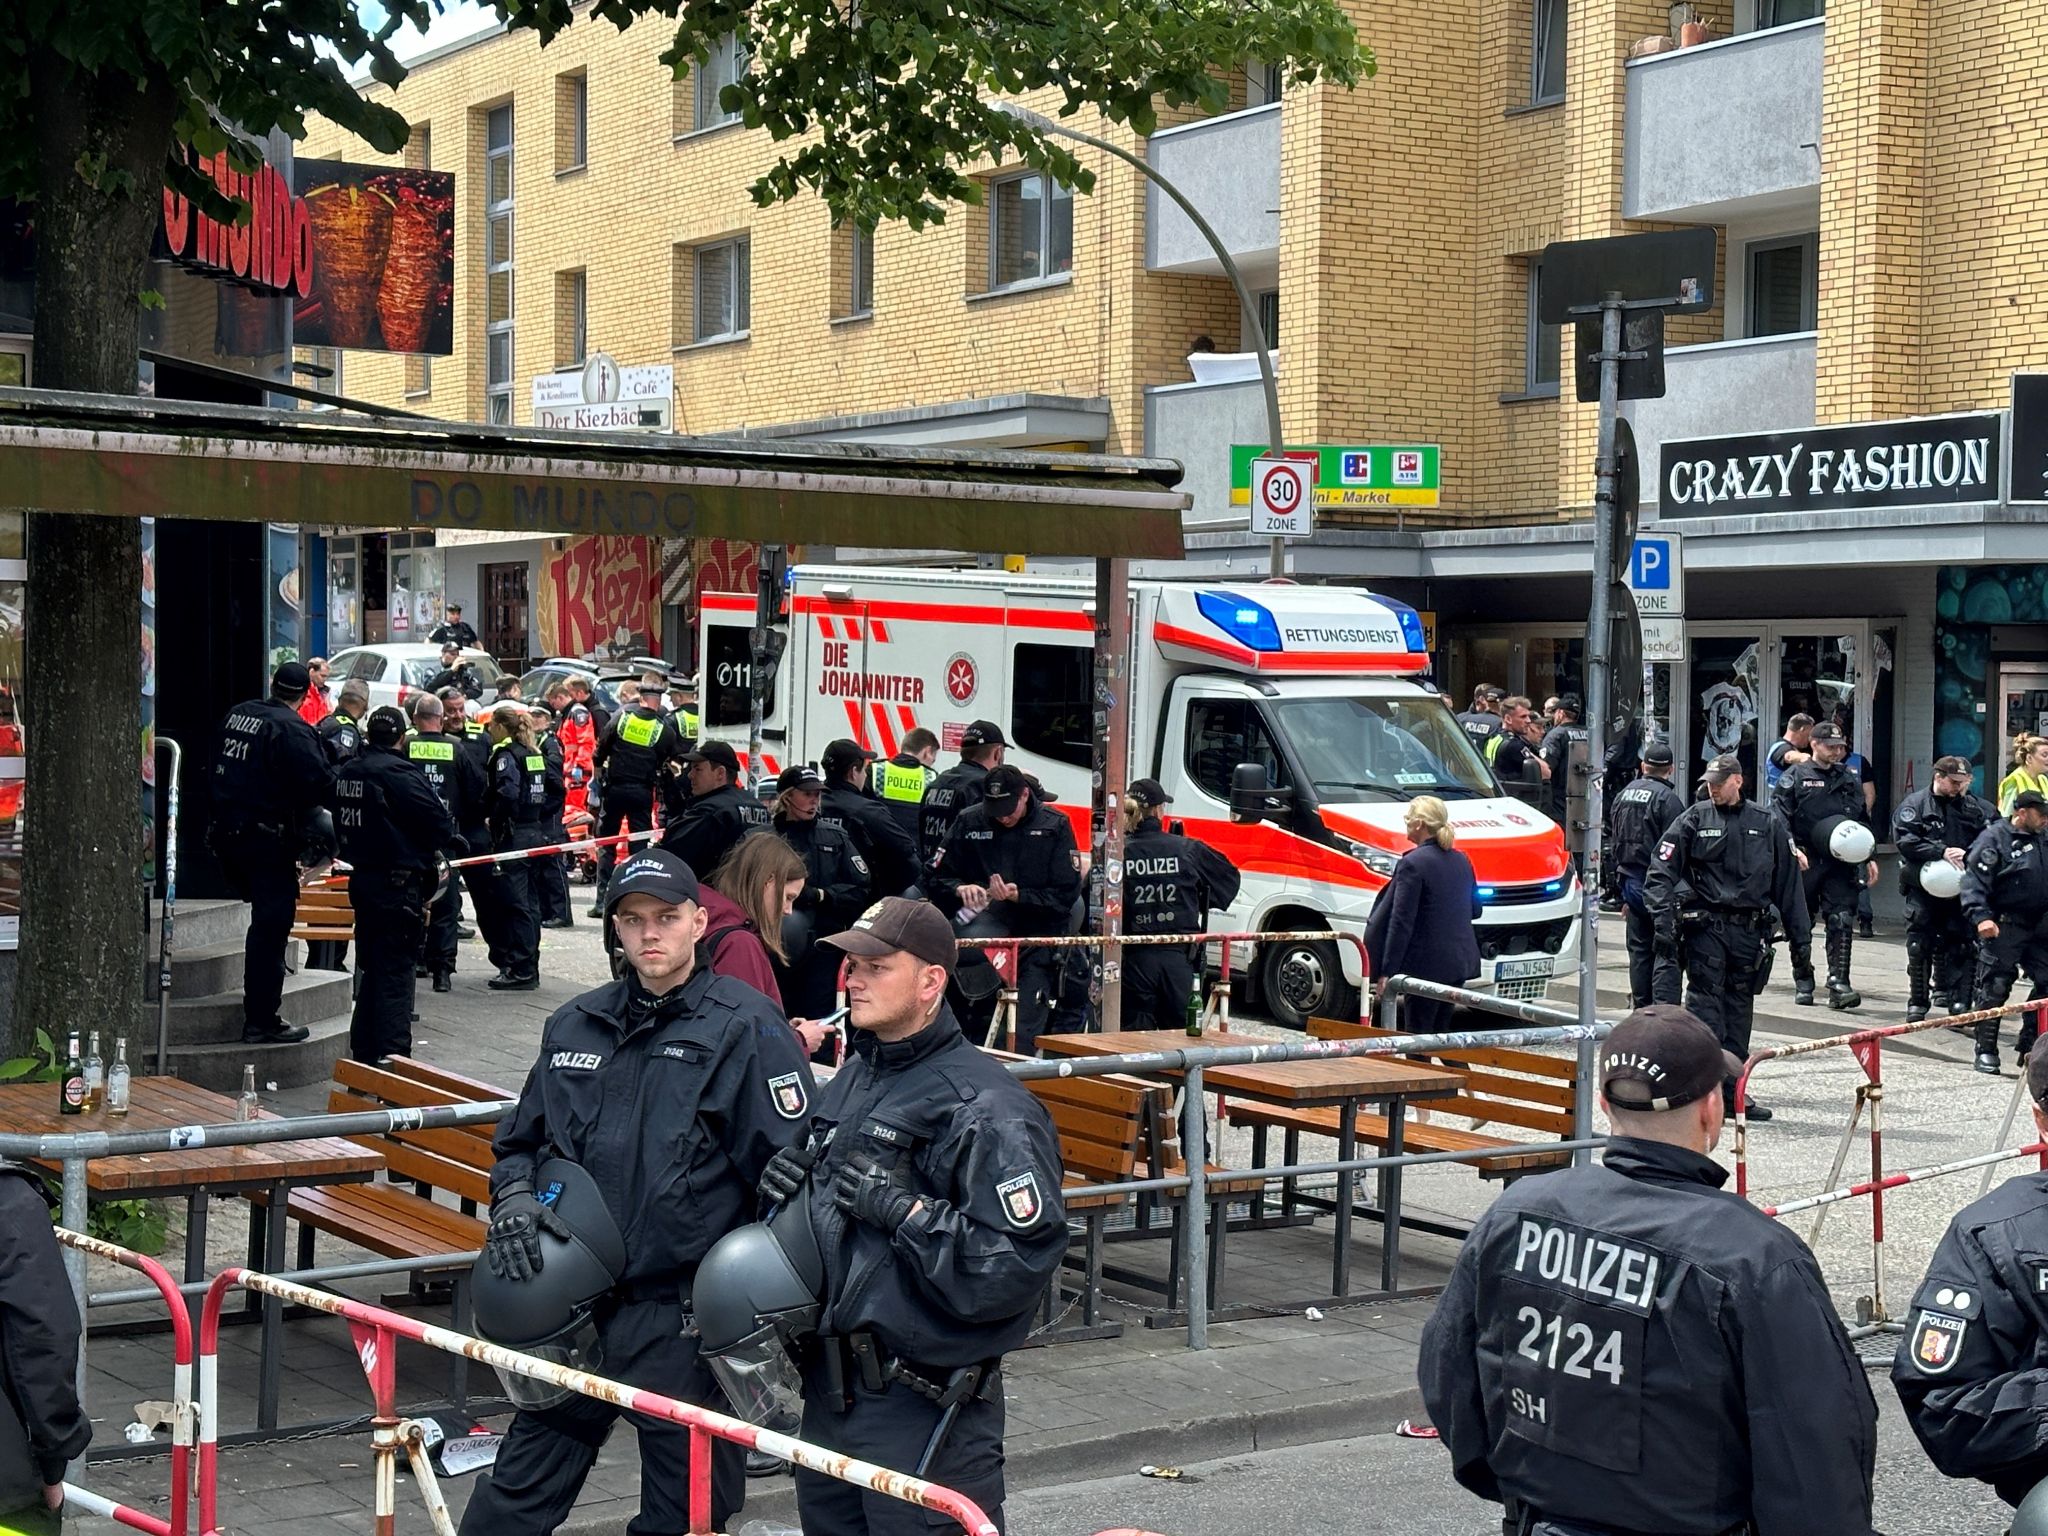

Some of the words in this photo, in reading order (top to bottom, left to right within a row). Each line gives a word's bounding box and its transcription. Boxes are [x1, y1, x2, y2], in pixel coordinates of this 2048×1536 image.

[633, 380, 658, 396] Café
[541, 411, 570, 430] Der
[1669, 442, 1803, 504] CRAZY
[1809, 437, 1990, 494] FASHION
[1270, 479, 1294, 502] 30
[1313, 490, 1330, 503] ini
[1343, 490, 1391, 504] Market
[411, 479, 483, 524] DO
[513, 484, 695, 533] MUNDO
[1266, 518, 1297, 531] ZONE
[1640, 546, 1661, 583] P
[1636, 596, 1668, 609] ZONE
[1285, 628, 1399, 643] RETTUNGSDIENST
[1643, 627, 1660, 638] mit
[823, 641, 849, 668] DIE
[733, 663, 752, 688] 11
[818, 669, 925, 704] JOHANNITER
[225, 713, 264, 735] POLIZEI
[627, 724, 651, 739] POLIZEI
[1464, 721, 1491, 735] POLIZEI
[424, 764, 438, 774] BE
[336, 779, 364, 798] POLIZEI
[887, 775, 923, 792] POLIZEI
[925, 788, 955, 808] POLIZEI
[1621, 789, 1652, 803] POLIZEI
[1697, 828, 1722, 838] POLIZEI
[625, 859, 664, 876] POLIZEI
[1126, 857, 1180, 876] POLIZEI
[1134, 883, 1177, 905] 2212
[1135, 914, 1152, 925] SH
[1502, 963, 1515, 978] HH
[549, 1051, 602, 1070] POLIZEI
[1604, 1052, 1667, 1082] POLIZEI
[771, 1075, 798, 1089] POLIZEI
[872, 1125, 897, 1141] 21243
[1000, 1176, 1032, 1196] POLIZEI
[1514, 1219, 1659, 1308] POLIZEI
[1922, 1313, 1963, 1332] POLIZEI
[1517, 1305, 1624, 1386] 2124
[1511, 1387, 1546, 1424] SH
